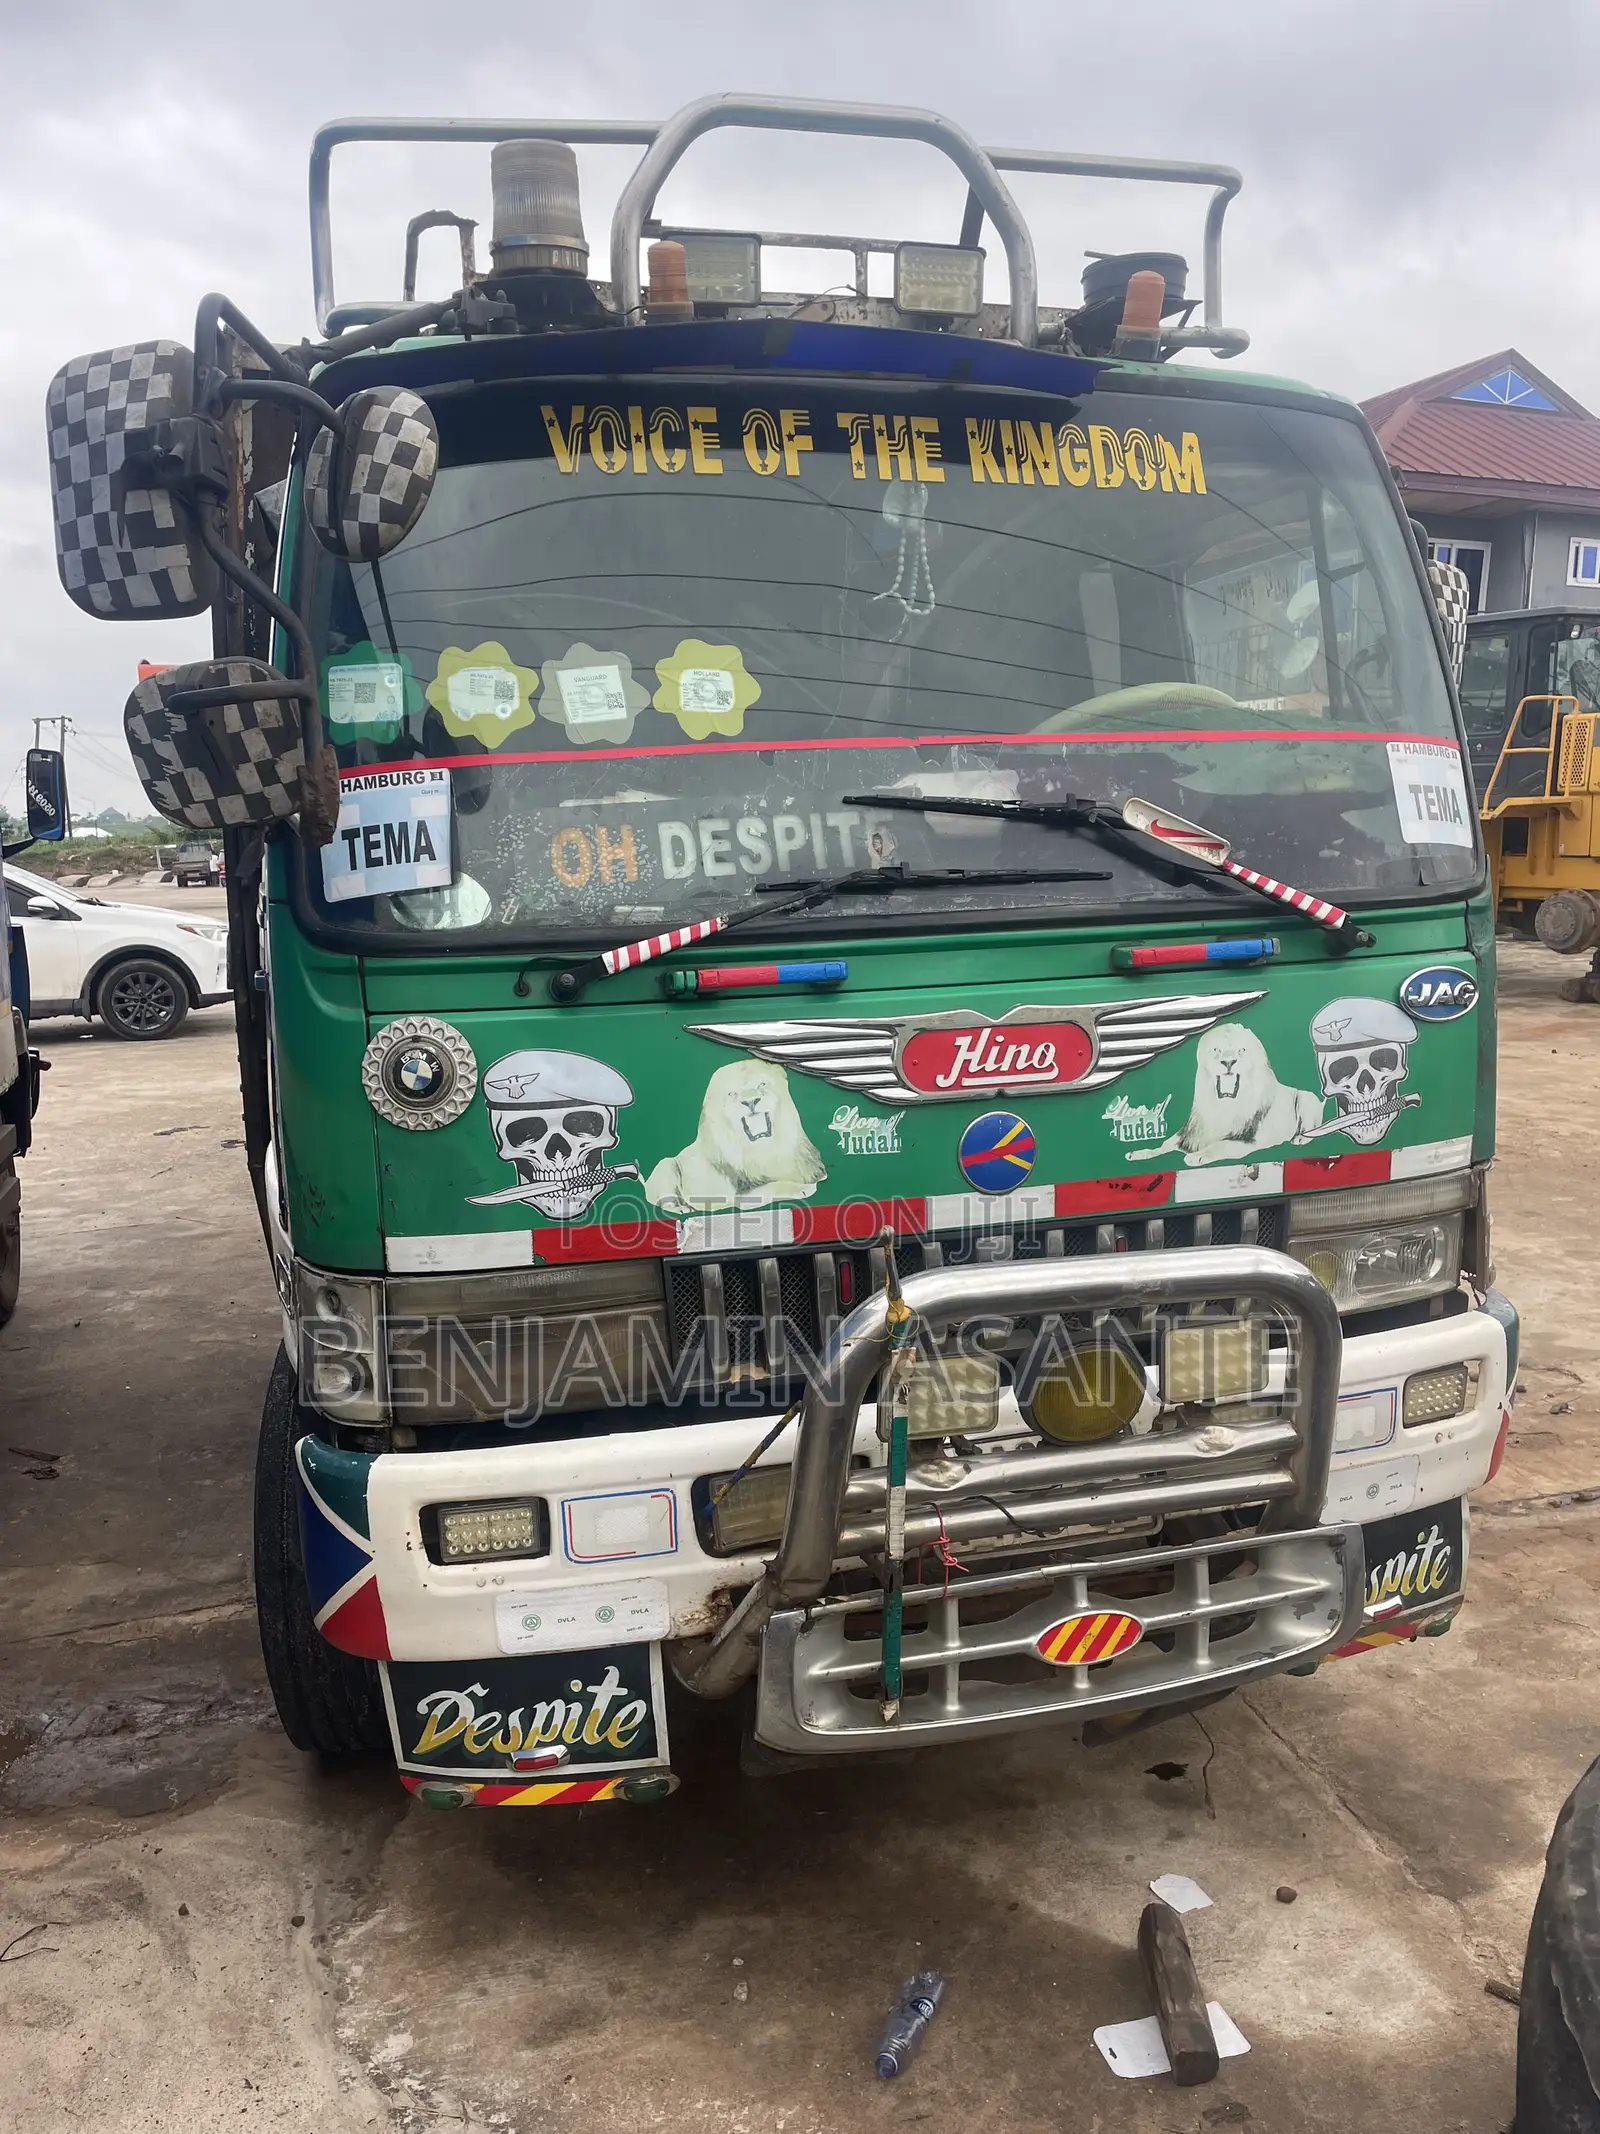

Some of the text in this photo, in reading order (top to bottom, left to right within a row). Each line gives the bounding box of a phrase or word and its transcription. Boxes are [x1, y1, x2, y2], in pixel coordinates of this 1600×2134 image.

[540, 405, 1207, 495] VOICE OF THE KINGDOM
[573, 674, 608, 682] VANGUARD
[1403, 743, 1451, 759] HAMBURG
[341, 771, 425, 793] HAMBURG
[1408, 784, 1463, 825] TEMA
[341, 820, 437, 871] TEMA
[552, 824, 638, 889] OH
[400, 1051, 440, 1073] BMW
[936, 1028, 1059, 1088] Hino
[828, 1105, 906, 1134] Lion of
[1102, 1094, 1172, 1119] Lion of
[838, 1130, 902, 1154] Judah
[1110, 1117, 1168, 1142] Judah
[1363, 1524, 1451, 1605] spite
[557, 1616, 576, 1624] DVLA
[411, 1665, 647, 1755] Despite
